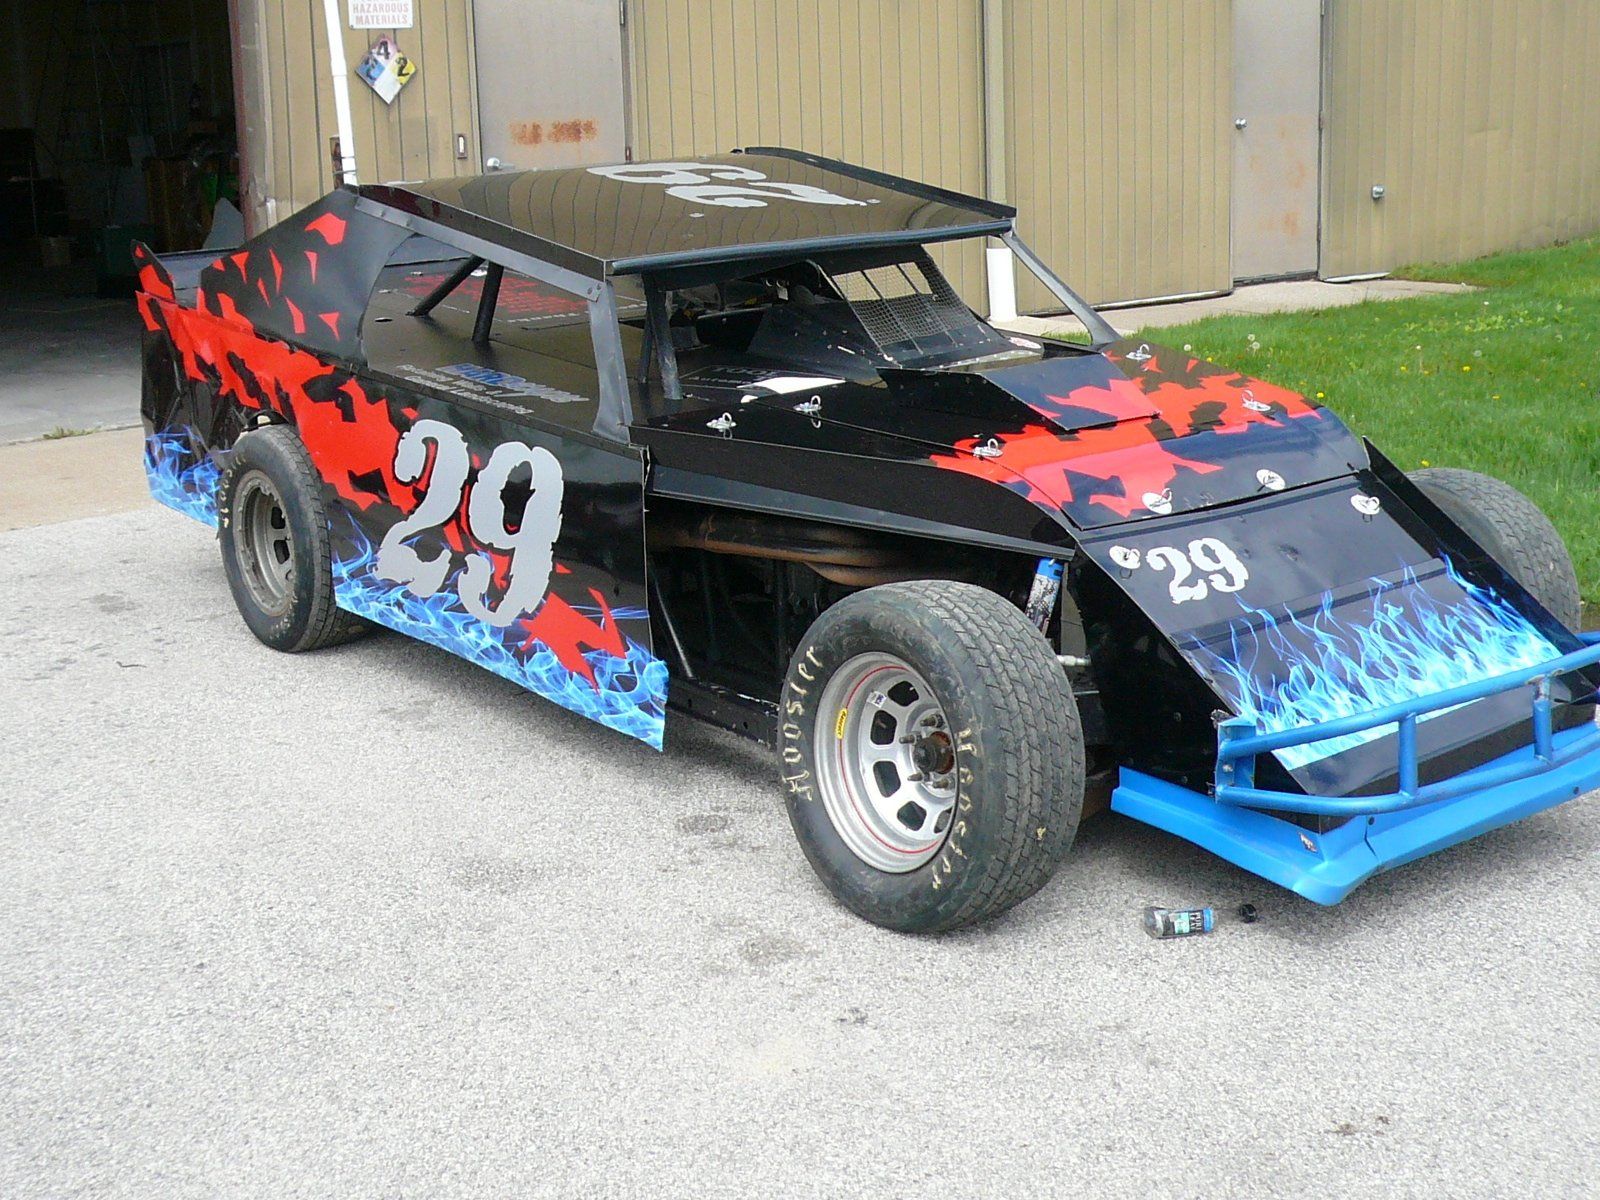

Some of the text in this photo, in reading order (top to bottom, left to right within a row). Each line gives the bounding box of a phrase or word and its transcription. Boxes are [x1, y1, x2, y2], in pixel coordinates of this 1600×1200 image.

[352, 3, 409, 14] HAZARDOUS
[355, 14, 408, 25] MATERIALS
[377, 40, 390, 60] 4
[395, 57, 410, 77] 2
[373, 419, 563, 627] 29
[1146, 537, 1249, 604] 29
